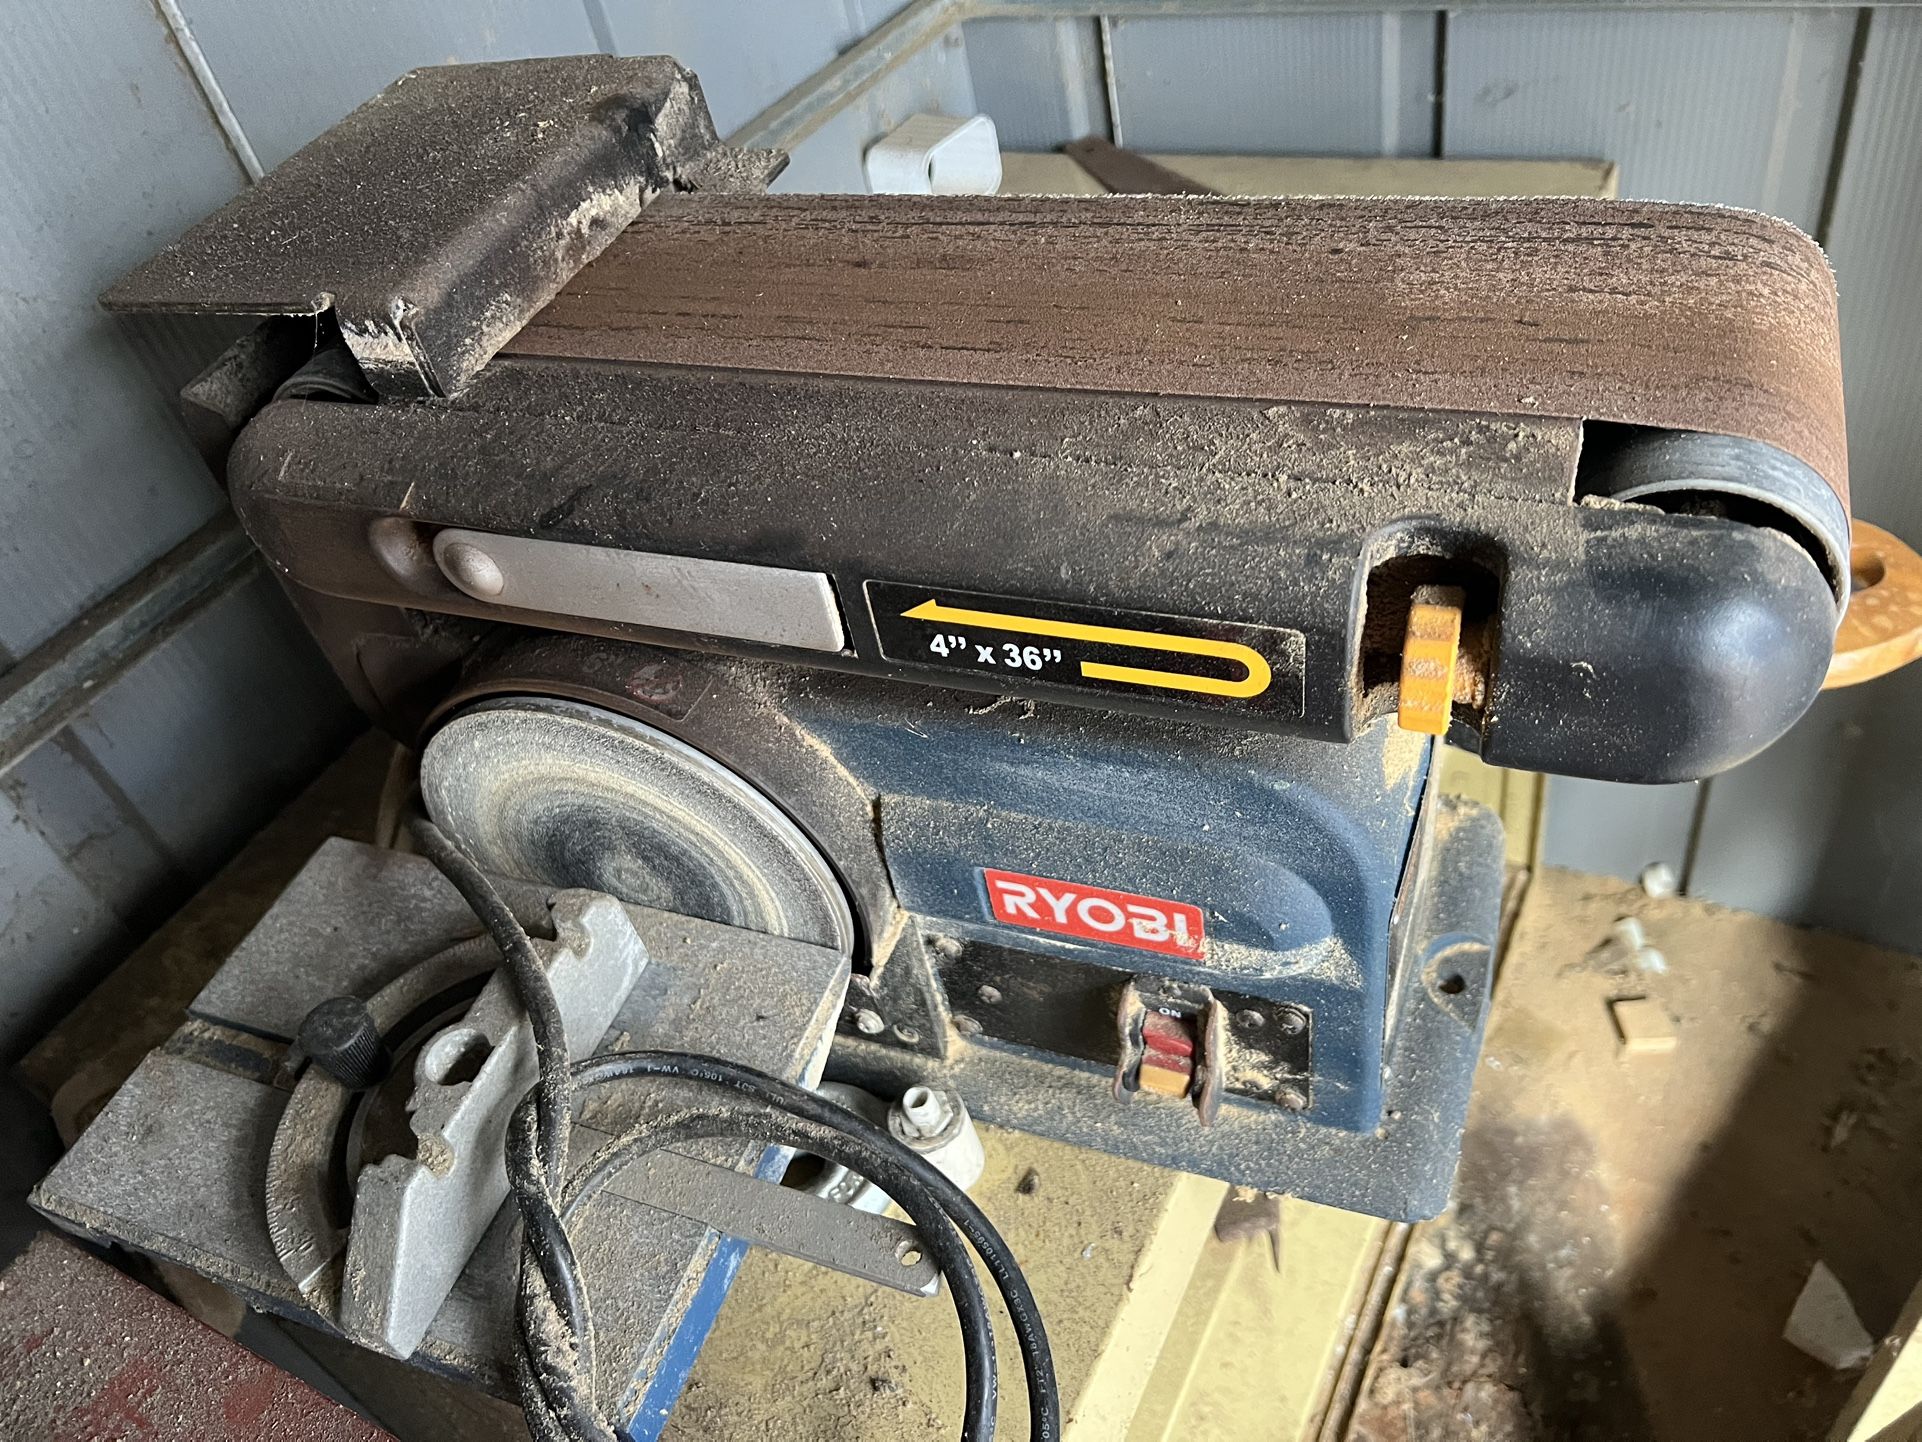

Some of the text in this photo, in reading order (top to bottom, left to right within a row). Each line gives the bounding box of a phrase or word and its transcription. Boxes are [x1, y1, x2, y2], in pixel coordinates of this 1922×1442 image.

[974, 644, 997, 665] x
[1002, 643, 1062, 671] 36”
[996, 880, 1190, 948] RYOBI
[1158, 1007, 1181, 1018] ON
[1010, 1289, 1039, 1357] 18AWGX3C
[1040, 1407, 1050, 1442] 05°C
